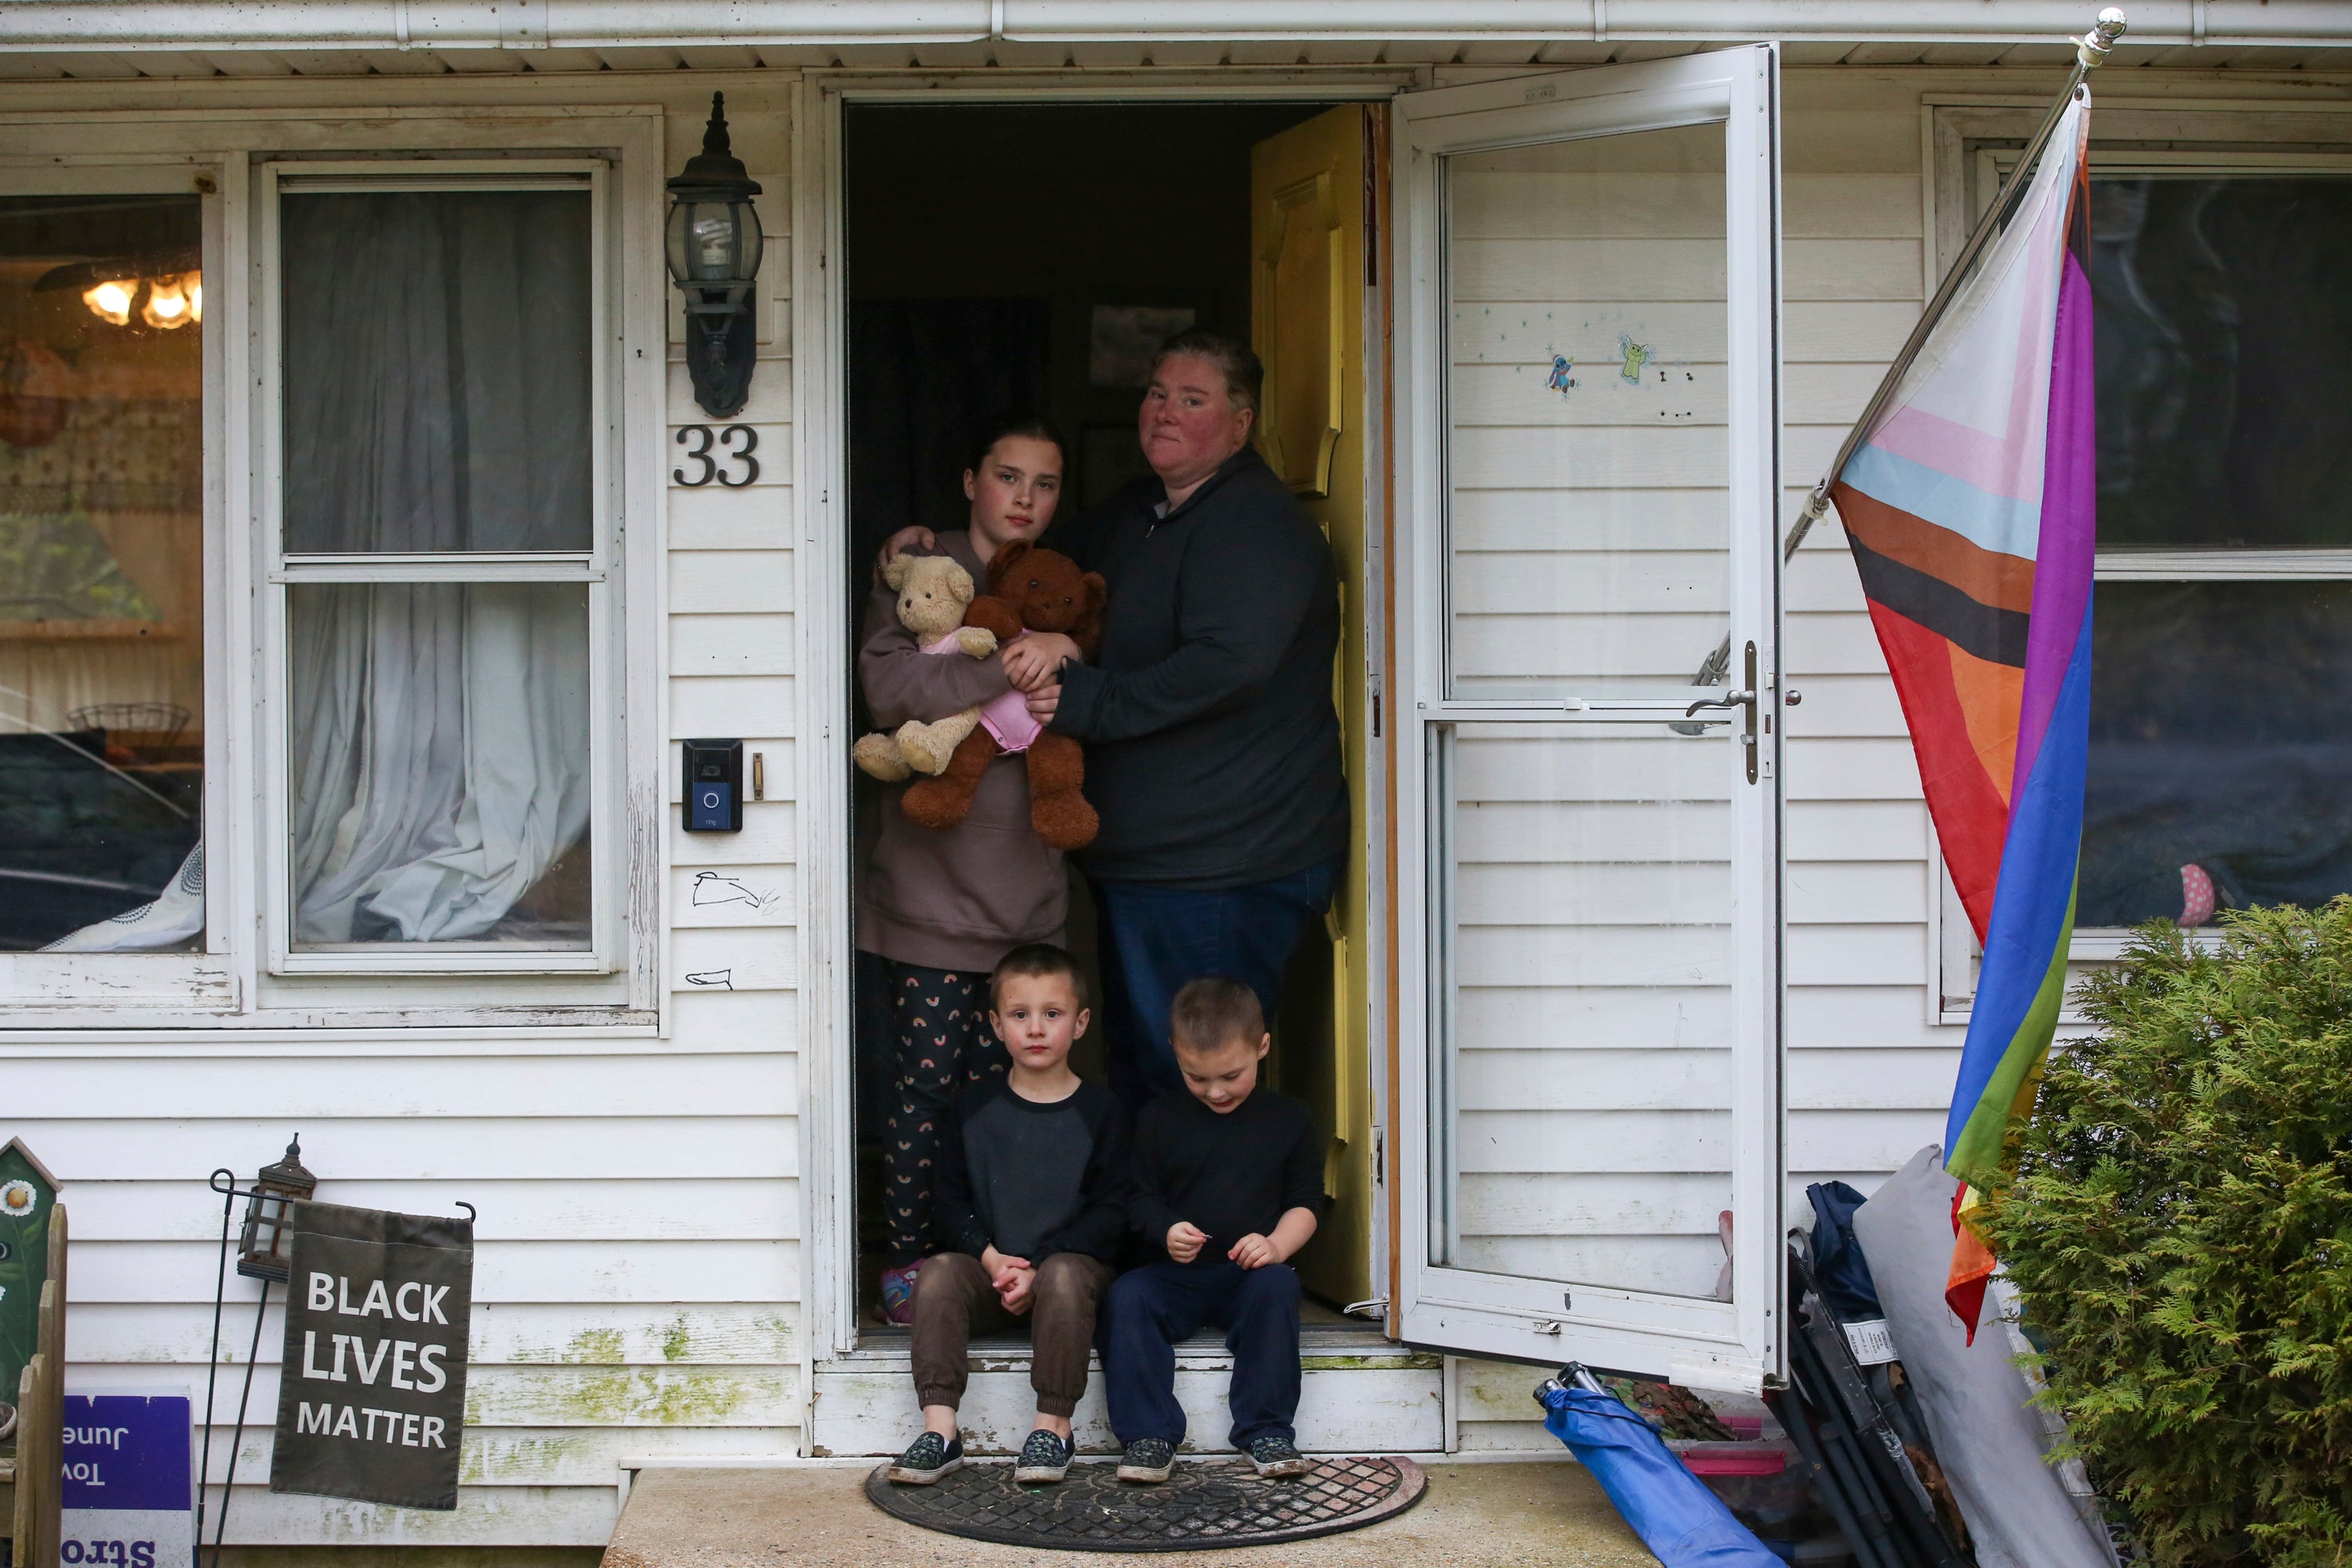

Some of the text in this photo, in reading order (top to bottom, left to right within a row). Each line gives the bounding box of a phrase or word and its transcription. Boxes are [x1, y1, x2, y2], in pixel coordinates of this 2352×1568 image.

[674, 424, 759, 487] 33
[308, 1272, 450, 1324] BLACK
[303, 1331, 447, 1392] LIVES
[64, 1427, 129, 1450] June
[297, 1402, 445, 1448] MATTER
[62, 1540, 155, 1568] Stro
